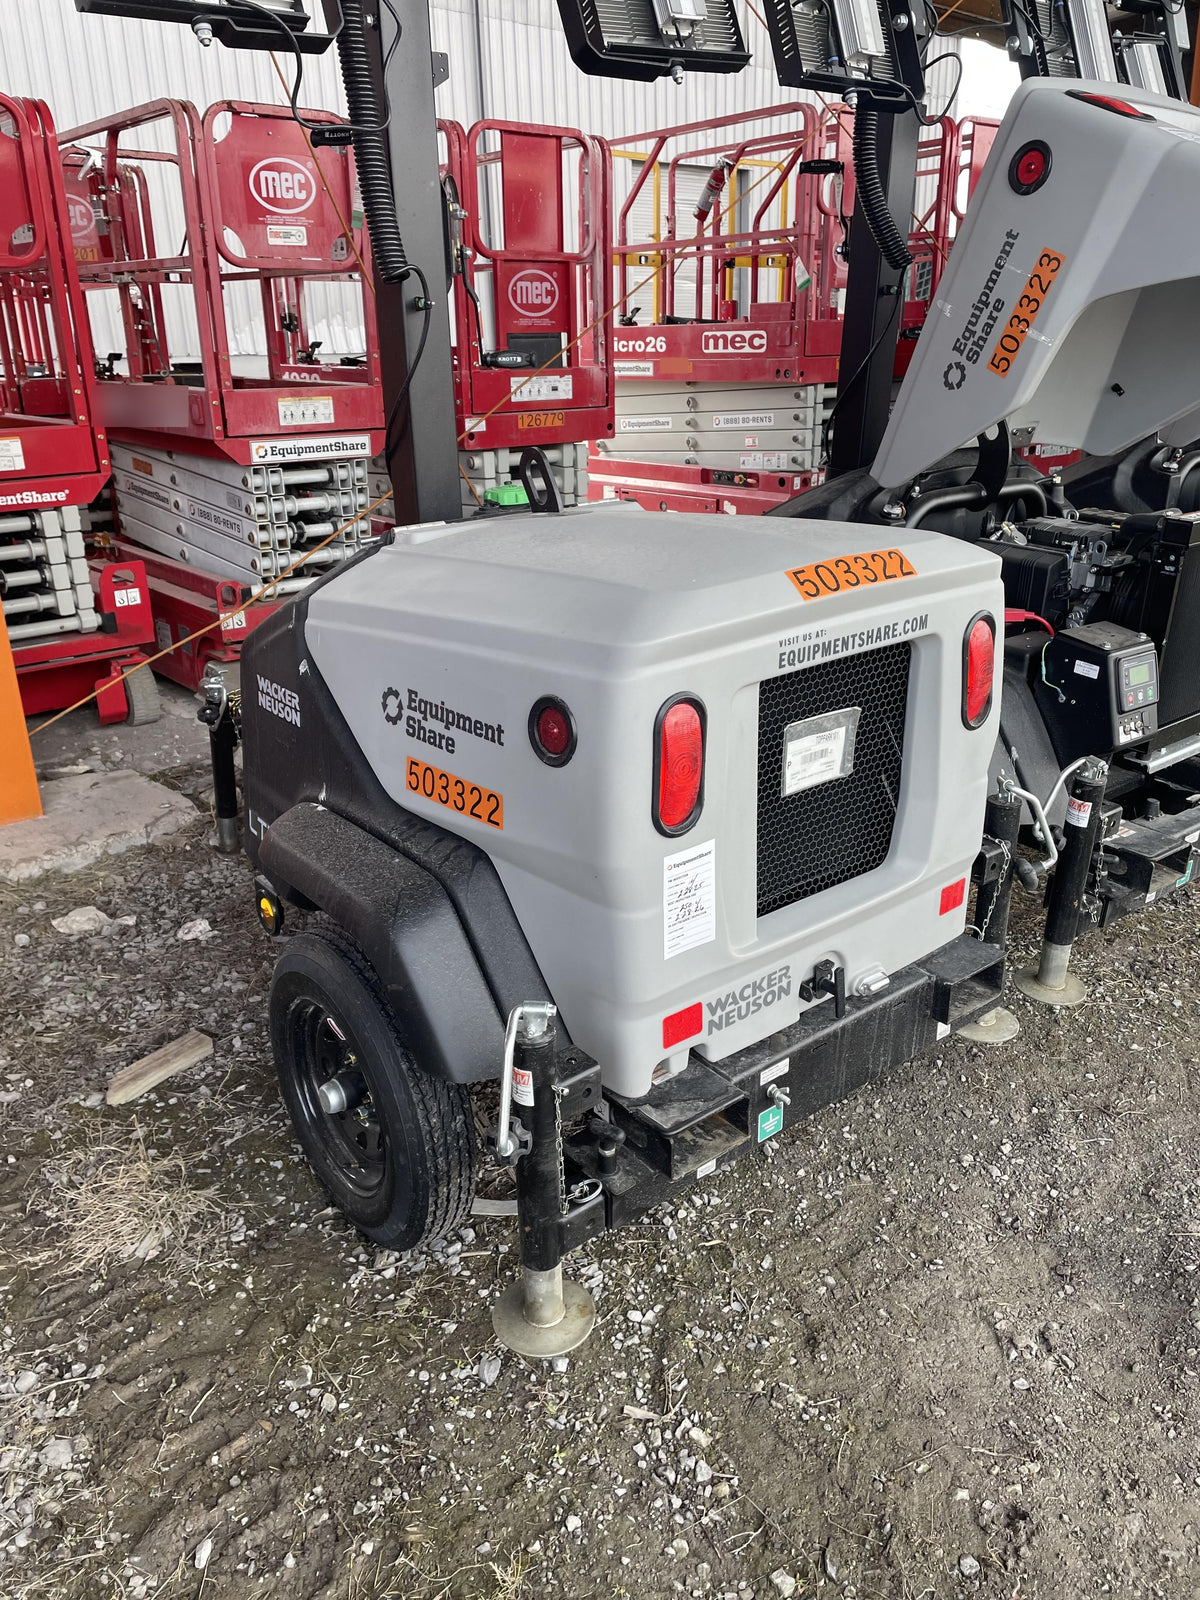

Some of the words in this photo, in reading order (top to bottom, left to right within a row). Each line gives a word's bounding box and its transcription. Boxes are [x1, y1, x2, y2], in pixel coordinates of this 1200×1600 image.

[260, 170, 307, 200] mec
[516, 281, 552, 304] mec
[952, 229, 1020, 357] Equipment
[990, 253, 1061, 373] 503323
[614, 336, 667, 353] icro26
[703, 333, 766, 351] mec
[965, 297, 1005, 365] Share
[519, 412, 564, 428] 126779
[723, 417, 741, 425] (888)
[741, 416, 773, 424] 80-RENTS
[269, 440, 367, 457] EquipmentShare
[0, 489, 67, 506] entShare
[197, 507, 213, 523] (888)
[213, 514, 241, 533] 80-RENTS
[792, 551, 914, 598] 503322
[778, 635, 799, 648] VISIT
[802, 631, 812, 641] US
[815, 629, 827, 639] AT:
[778, 614, 929, 669] EQUIPMENTSHARE.COM
[256, 674, 300, 711] WACKER
[258, 690, 301, 728] NEUSON
[405, 715, 456, 754] Share
[406, 688, 505, 747] Equipment
[408, 760, 501, 827] 503322
[249, 809, 270, 841] LT
[673, 850, 712, 869] EquipmentShare
[706, 965, 792, 1017] WACKER
[707, 980, 792, 1037] NEUSON
